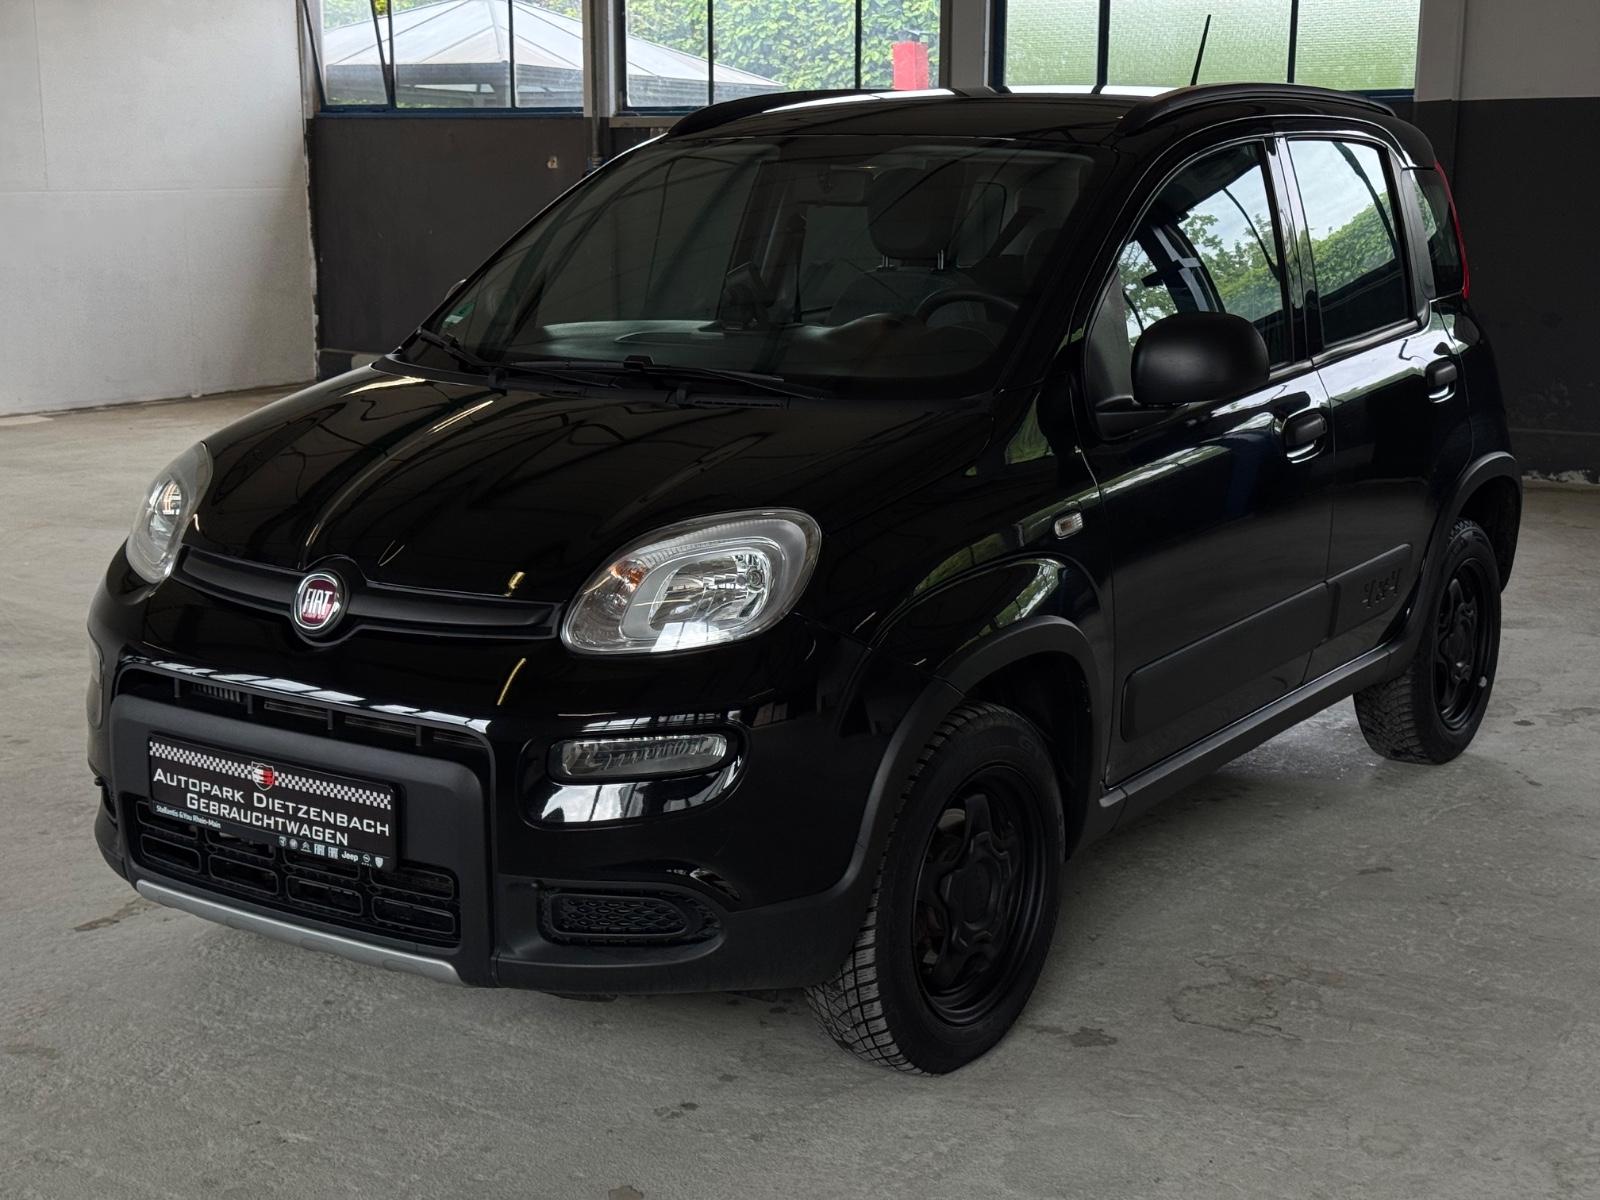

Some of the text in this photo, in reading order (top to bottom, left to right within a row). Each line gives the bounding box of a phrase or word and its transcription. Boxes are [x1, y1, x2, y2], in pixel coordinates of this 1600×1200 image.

[302, 588, 334, 616] FIAT
[153, 768, 390, 836] AUTOPARK DIETZENBACH
[187, 793, 348, 846] GEBRAUCHTWAGEN
[342, 851, 359, 862] Jeep
